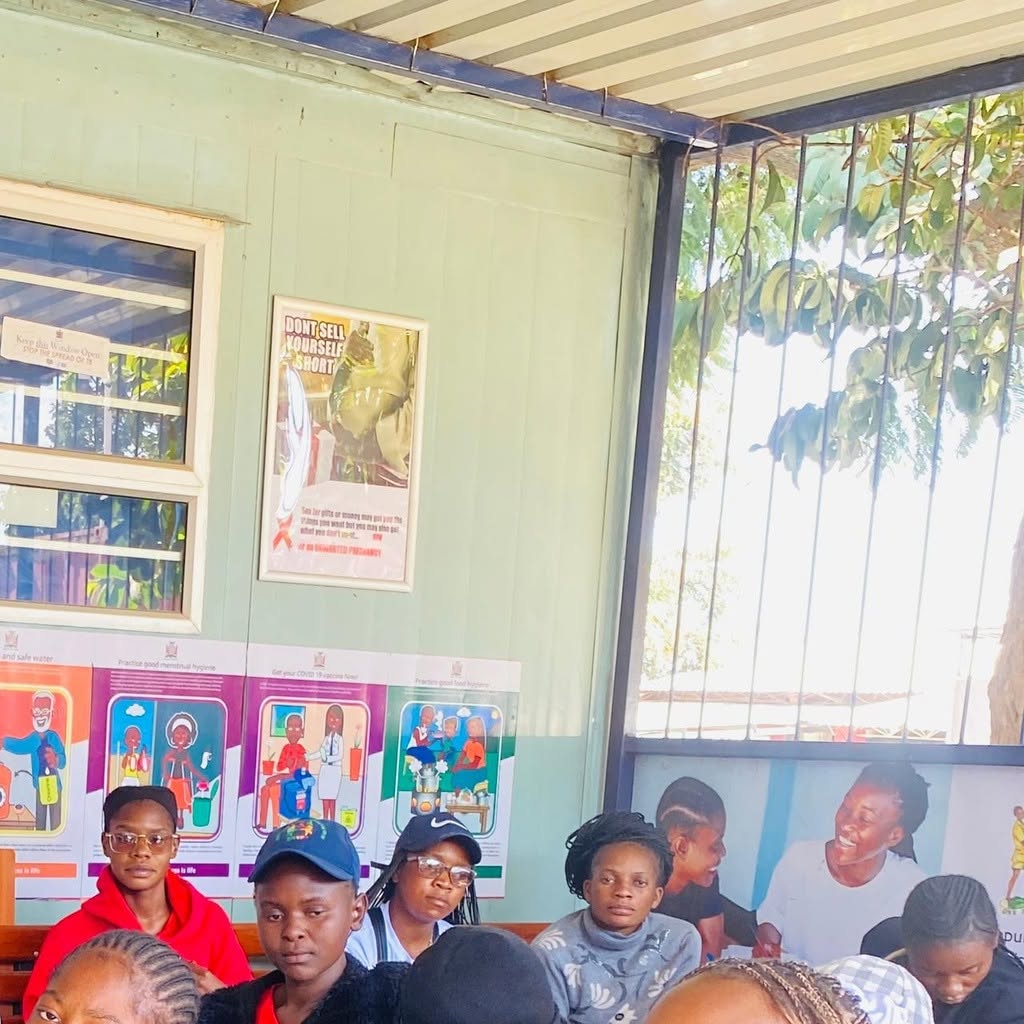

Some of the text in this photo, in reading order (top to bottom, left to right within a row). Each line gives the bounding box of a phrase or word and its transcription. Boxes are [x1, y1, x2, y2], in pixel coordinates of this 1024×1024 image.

[319, 321, 345, 340] SELL
[16, 335, 35, 347] Keep
[50, 341, 80, 354] Window
[81, 347, 100, 359] Open
[286, 335, 344, 357] YOURSELF
[296, 353, 335, 374] SHORT
[187, 866, 196, 874] life
